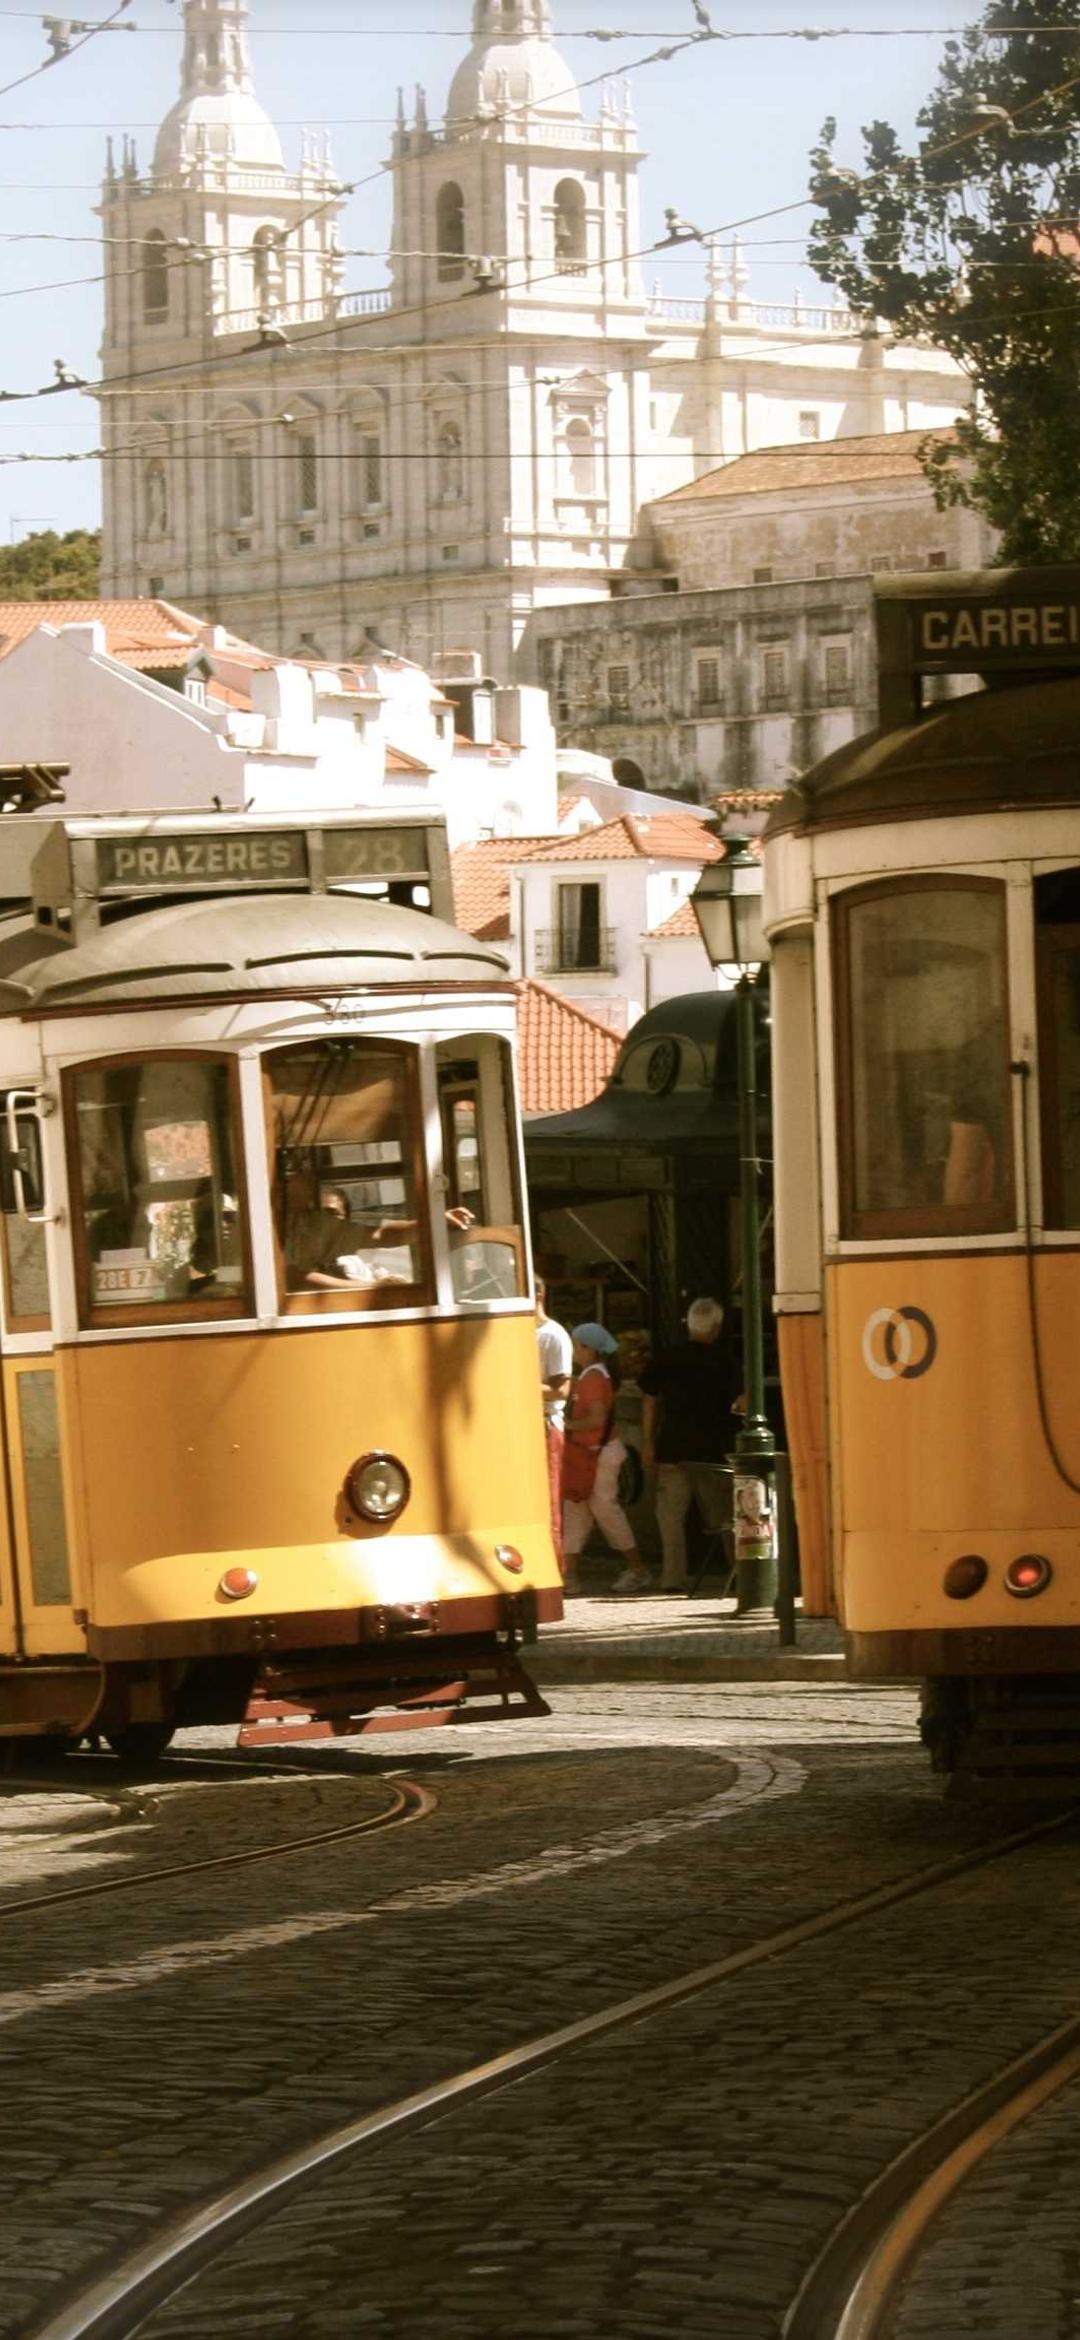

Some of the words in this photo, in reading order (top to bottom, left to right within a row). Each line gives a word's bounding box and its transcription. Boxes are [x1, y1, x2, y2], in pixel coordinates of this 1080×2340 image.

[922, 605, 1079, 650] CARREI
[115, 838, 291, 878] PRAZERES
[342, 836, 405, 875] 28
[96, 1269, 129, 1291] 28E
[135, 1269, 148, 1286] 7
